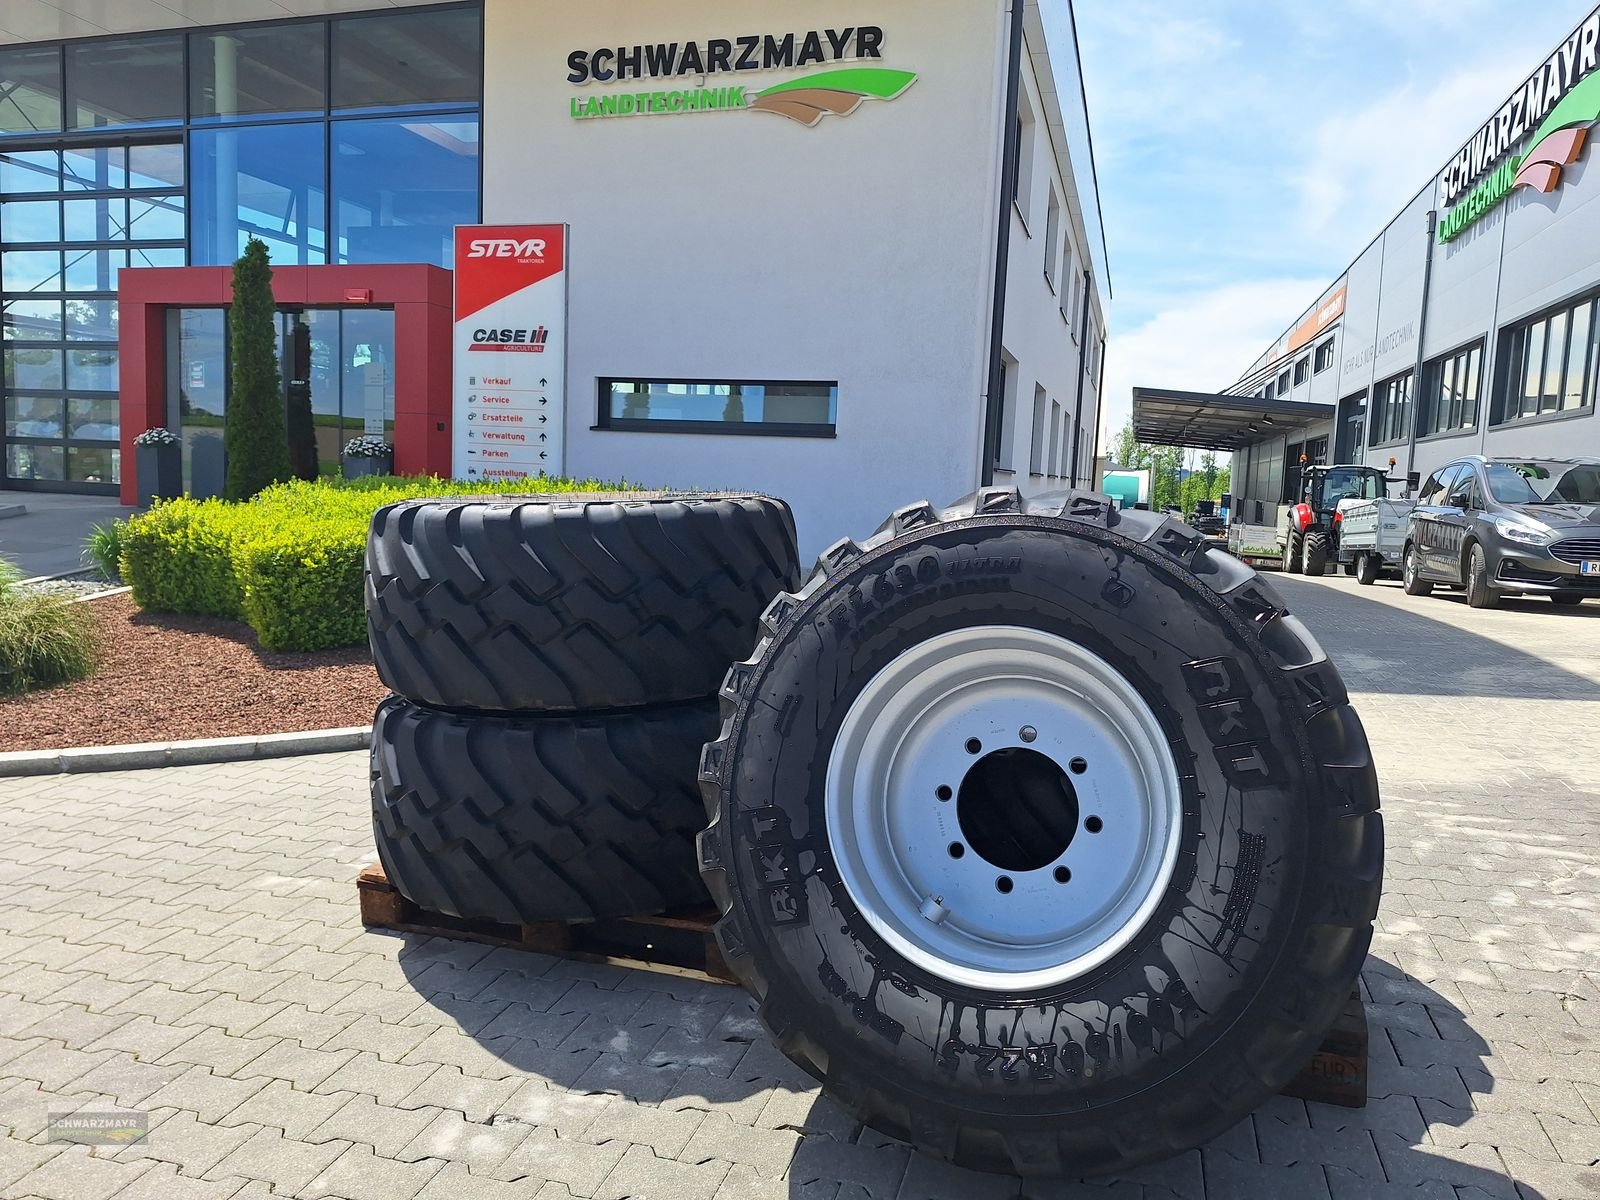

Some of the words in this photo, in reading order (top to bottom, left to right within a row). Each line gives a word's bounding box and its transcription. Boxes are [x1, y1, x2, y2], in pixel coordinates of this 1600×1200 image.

[566, 26, 884, 83] SCHWARZMAYR
[570, 86, 748, 119] LANDTECHNIK
[1440, 14, 1600, 208] SCHWARZMAYR
[1438, 157, 1520, 244] LANDTECHNIK
[466, 239, 546, 258] STEYR
[473, 329, 527, 343] CASE
[482, 377, 511, 385] Verkauf
[482, 396, 510, 404] Service
[482, 413, 523, 422] Ersatzteile
[482, 432, 525, 441] Verwaltung
[482, 449, 509, 457] Parken
[1591, 563, 1600, 573] R
